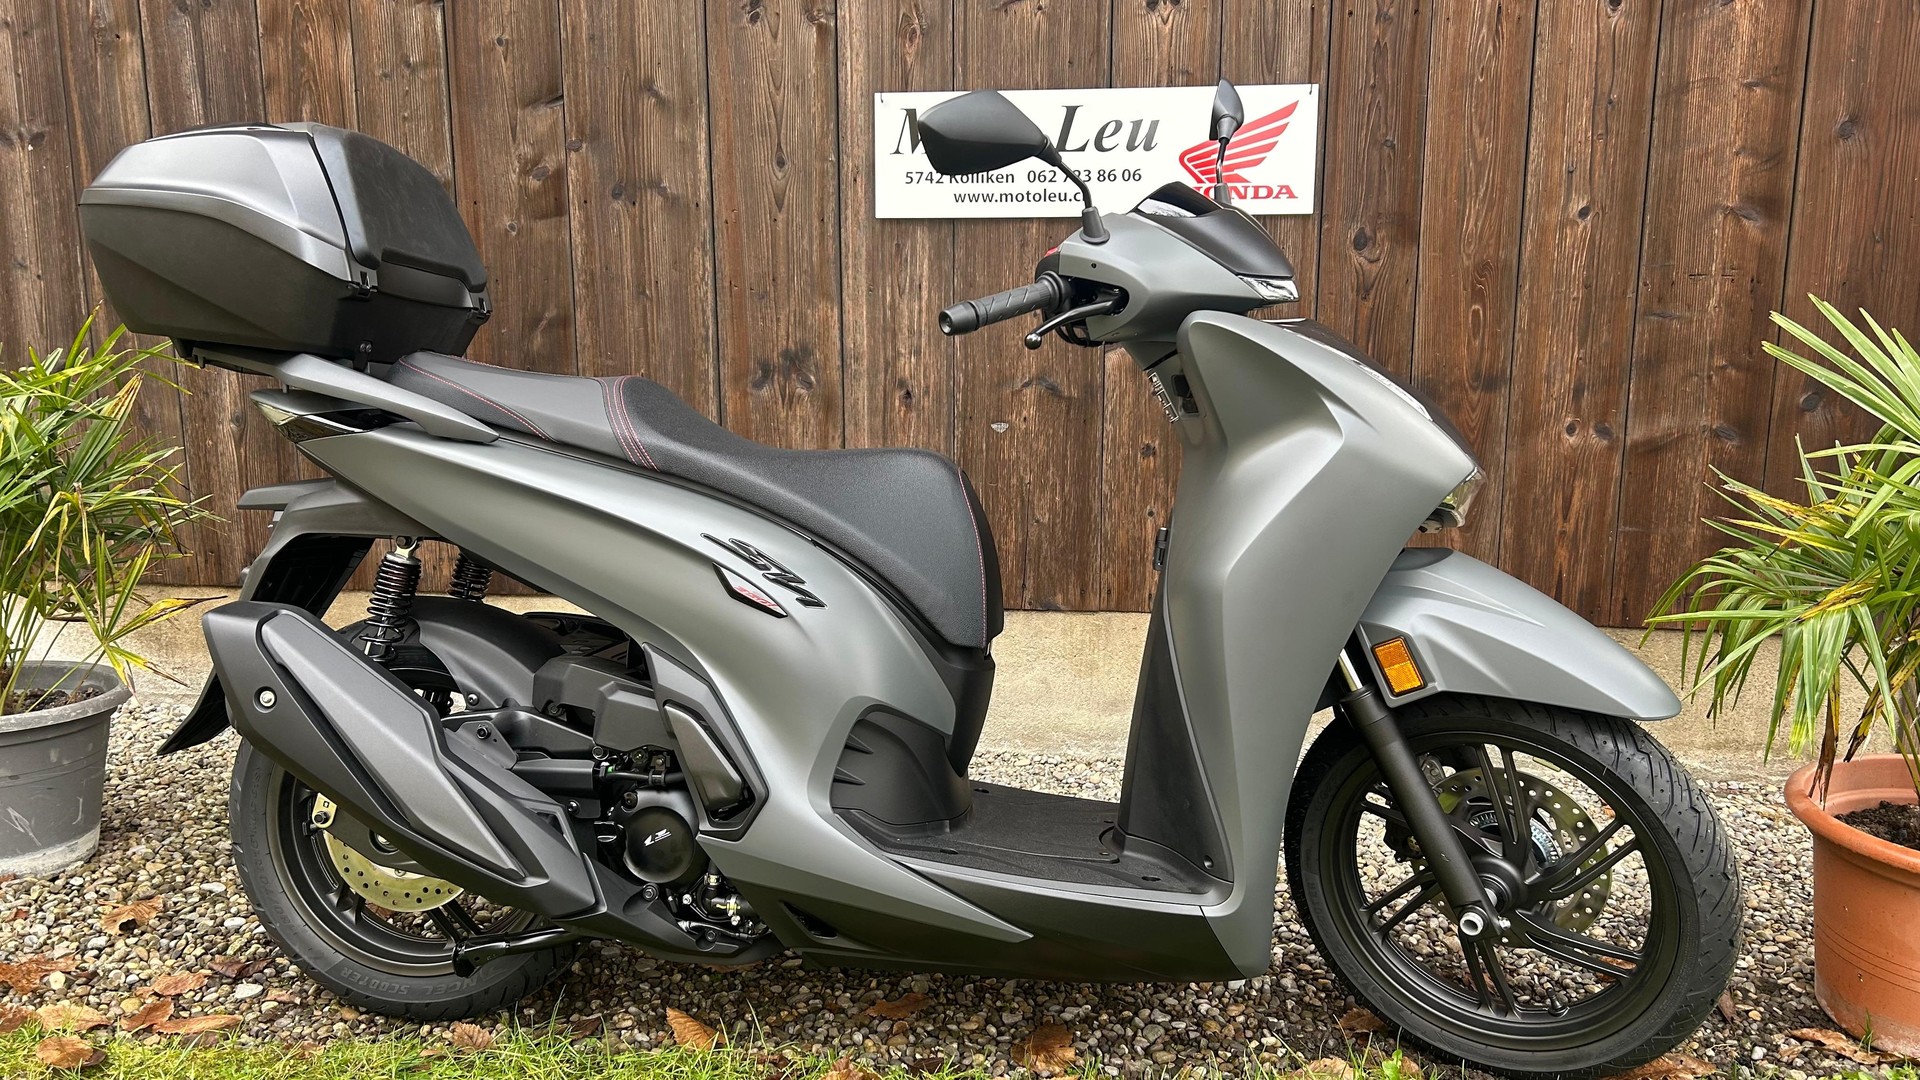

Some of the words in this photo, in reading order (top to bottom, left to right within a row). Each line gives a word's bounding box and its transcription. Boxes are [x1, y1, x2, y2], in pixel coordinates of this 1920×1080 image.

[1056, 104, 1160, 153] Leu
[905, 171, 944, 184] 5742
[1027, 169, 1058, 183] 062
[1096, 168, 1118, 183] 86
[1121, 167, 1143, 182] 06
[953, 188, 1082, 203] www.motoleu.c
[1192, 184, 1299, 200] NDA
[339, 966, 410, 995] SCOOTER
